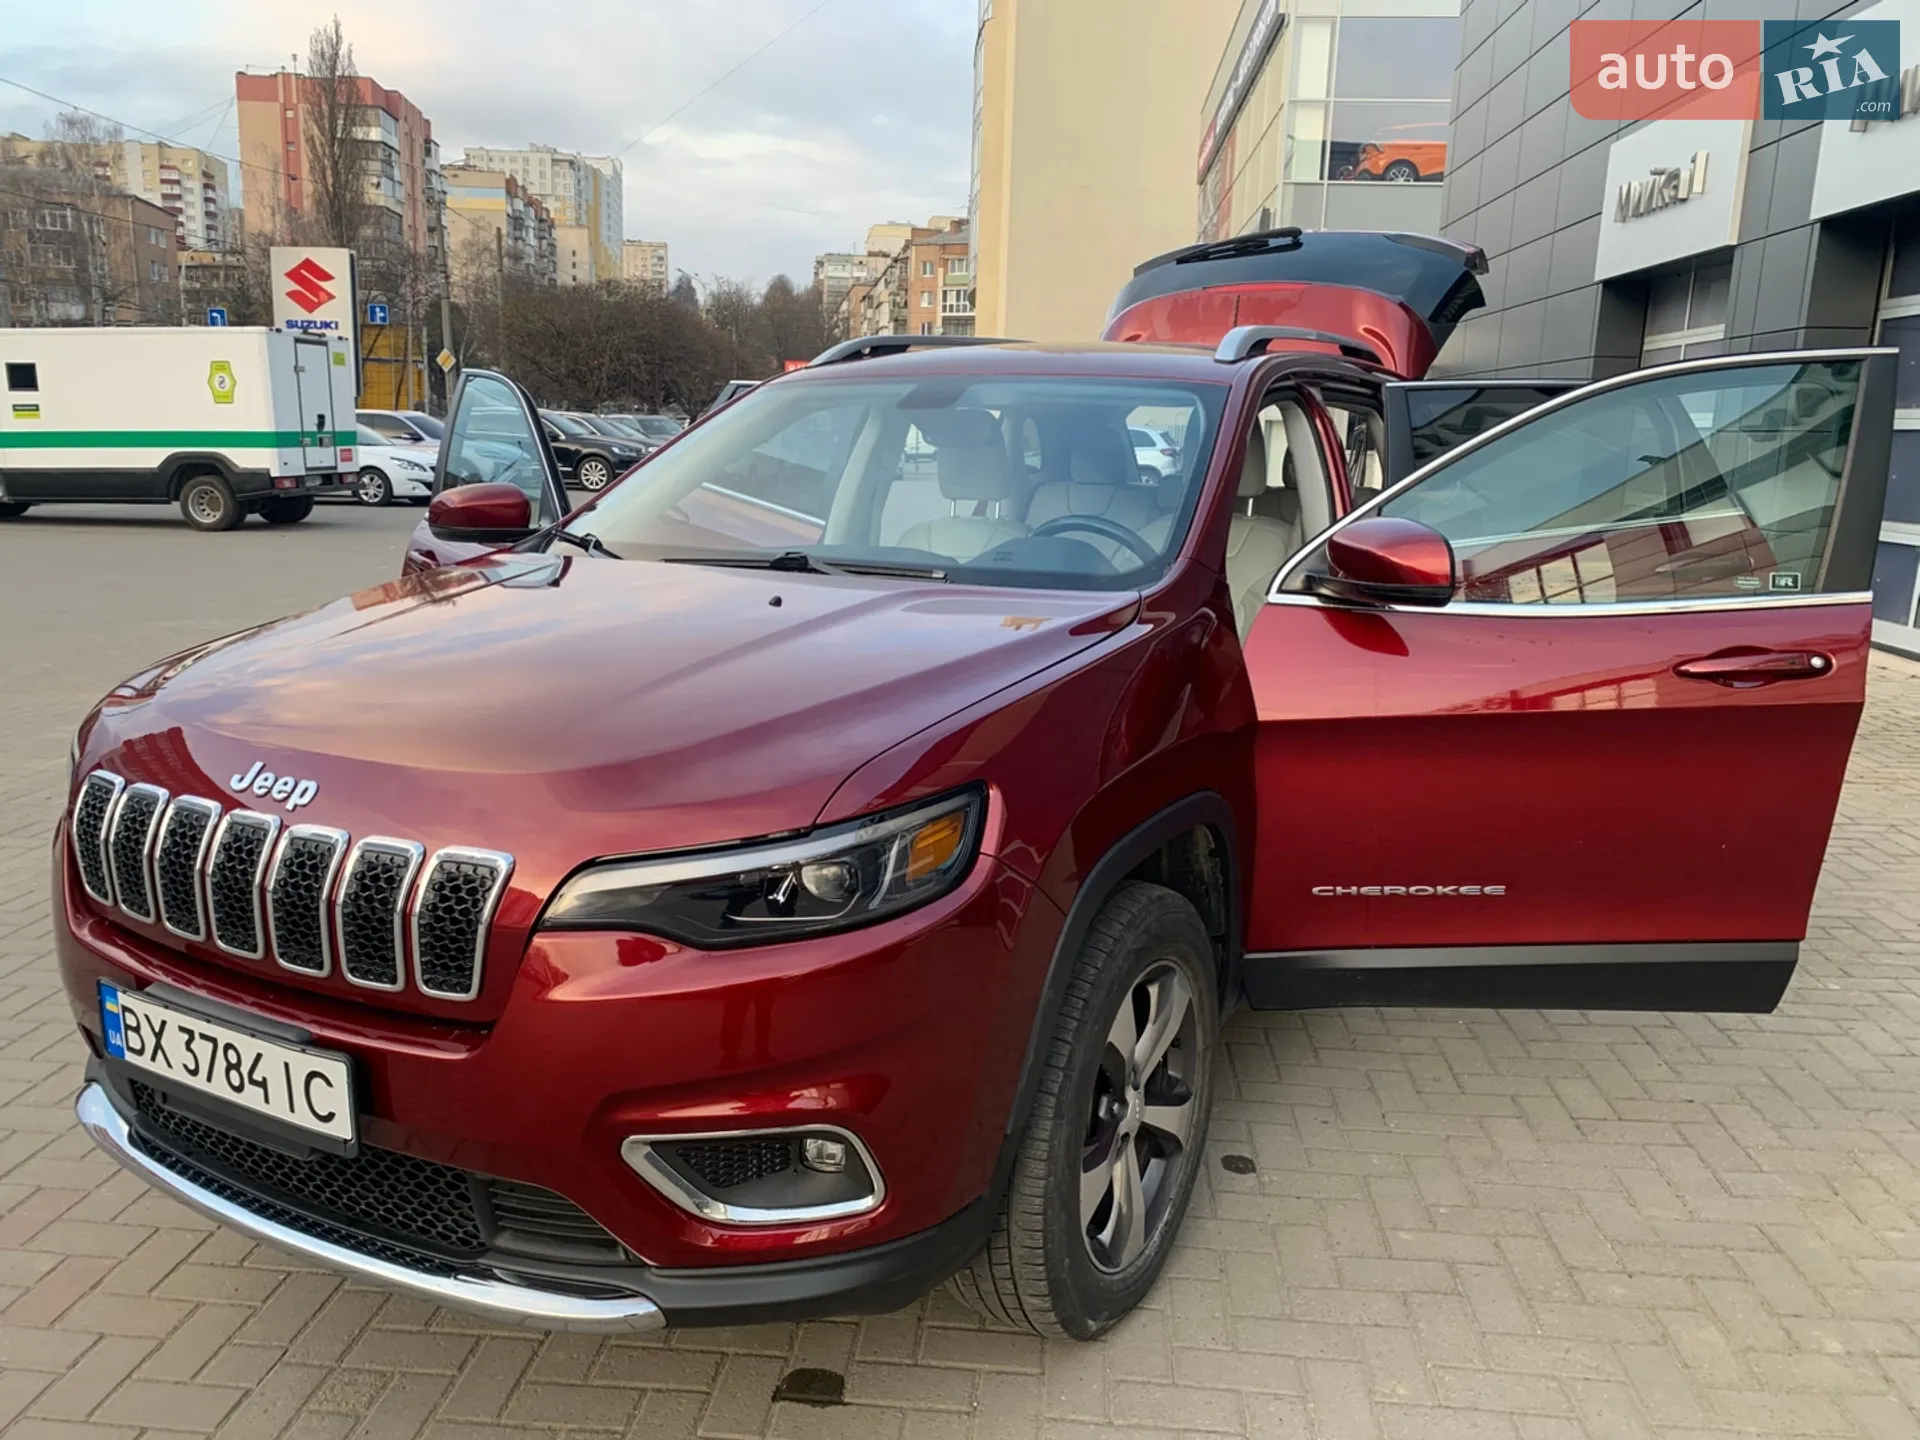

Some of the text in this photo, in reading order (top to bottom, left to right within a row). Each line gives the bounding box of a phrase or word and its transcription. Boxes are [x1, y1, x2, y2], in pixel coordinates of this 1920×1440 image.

[285, 319, 339, 331] SUZUKI
[229, 760, 320, 813] Jeep
[1311, 885, 1507, 897] CHEROKEE
[109, 1029, 123, 1048] UA
